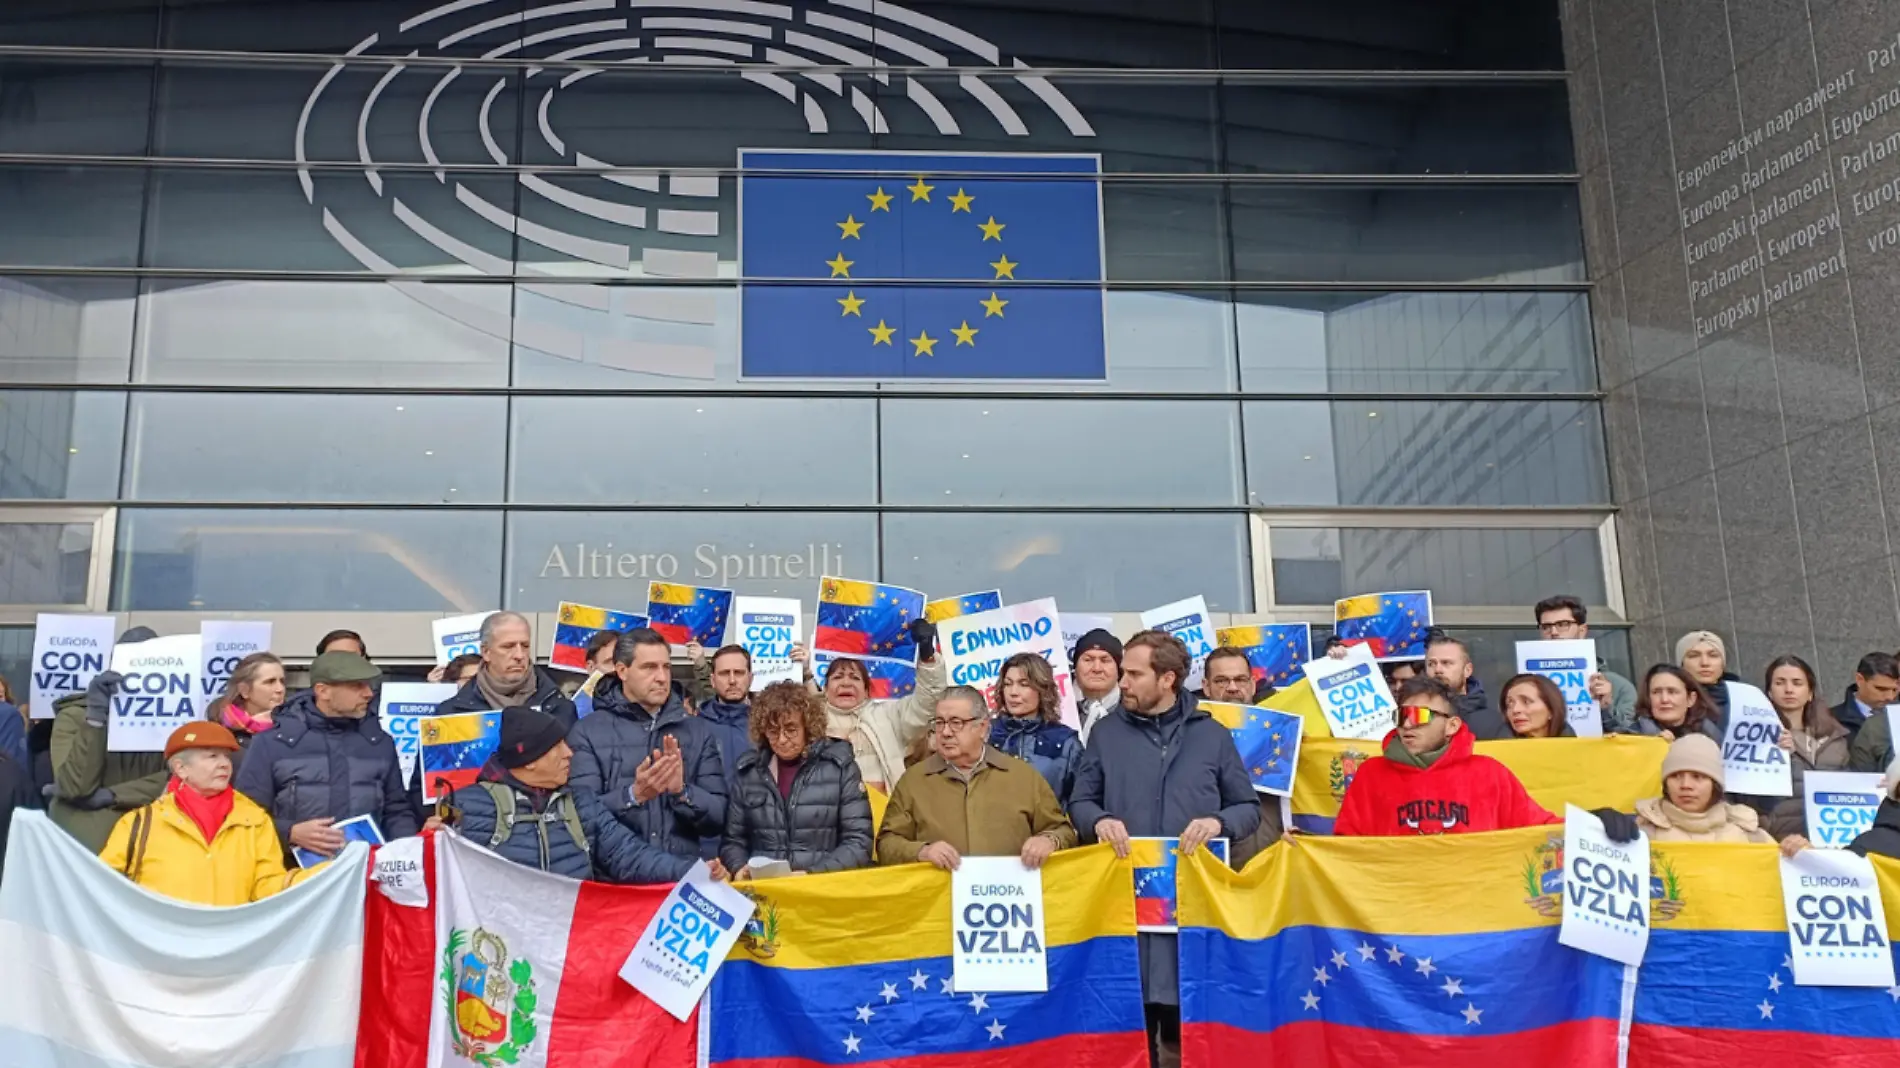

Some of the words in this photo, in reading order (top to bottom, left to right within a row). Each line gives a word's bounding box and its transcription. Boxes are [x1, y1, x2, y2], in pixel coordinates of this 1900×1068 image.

[1677, 127, 1763, 192] Европейски
[1765, 69, 1855, 138] парламент
[1682, 184, 1740, 228] Euroopa
[1741, 131, 1822, 194] Parlament
[1686, 215, 1747, 265] Europski
[1750, 168, 1830, 236] parlament
[1691, 249, 1765, 301] Parlament
[1767, 210, 1841, 262] Ewropew
[1695, 293, 1760, 339] Europsky
[1763, 247, 1847, 308] parlament
[539, 543, 678, 579] Altiero
[694, 542, 844, 588] Spinelli
[49, 636, 98, 647] EUROPA
[745, 626, 791, 641] CON
[951, 616, 1052, 656] EDMUNDO
[1173, 625, 1204, 643] ON
[215, 642, 258, 651] EUROPA
[1187, 641, 1213, 658] LA
[41, 651, 103, 672] CON
[129, 656, 184, 667] EUROPA
[207, 656, 242, 675] CO
[1539, 660, 1576, 669] EUROPA
[34, 671, 87, 691] VZL
[120, 672, 190, 695] CON
[1548, 671, 1584, 688] ON
[1328, 678, 1376, 706] CON
[113, 696, 195, 718] VZLA
[400, 705, 436, 713] EUROPA
[1330, 693, 1390, 723] VZLA
[389, 717, 419, 735] CO
[1733, 721, 1781, 744] CON
[1723, 742, 1787, 765] VZLA
[1828, 794, 1867, 804] EUROPA
[1397, 799, 1470, 827] CHICAGO
[1820, 807, 1877, 825] CON
[1579, 838, 1631, 863] EUROPA
[1573, 856, 1639, 898] CON
[1800, 876, 1860, 888] EUROPA
[971, 884, 1024, 896] EUROPA
[688, 891, 721, 921] EUROPA
[963, 903, 1033, 928] CON
[1567, 880, 1646, 928] VZLA
[1796, 894, 1873, 920] CON
[669, 902, 720, 949] CON
[1792, 922, 1886, 947] VZLA
[655, 918, 709, 975] VZLA
[957, 930, 1042, 954] VZLA
